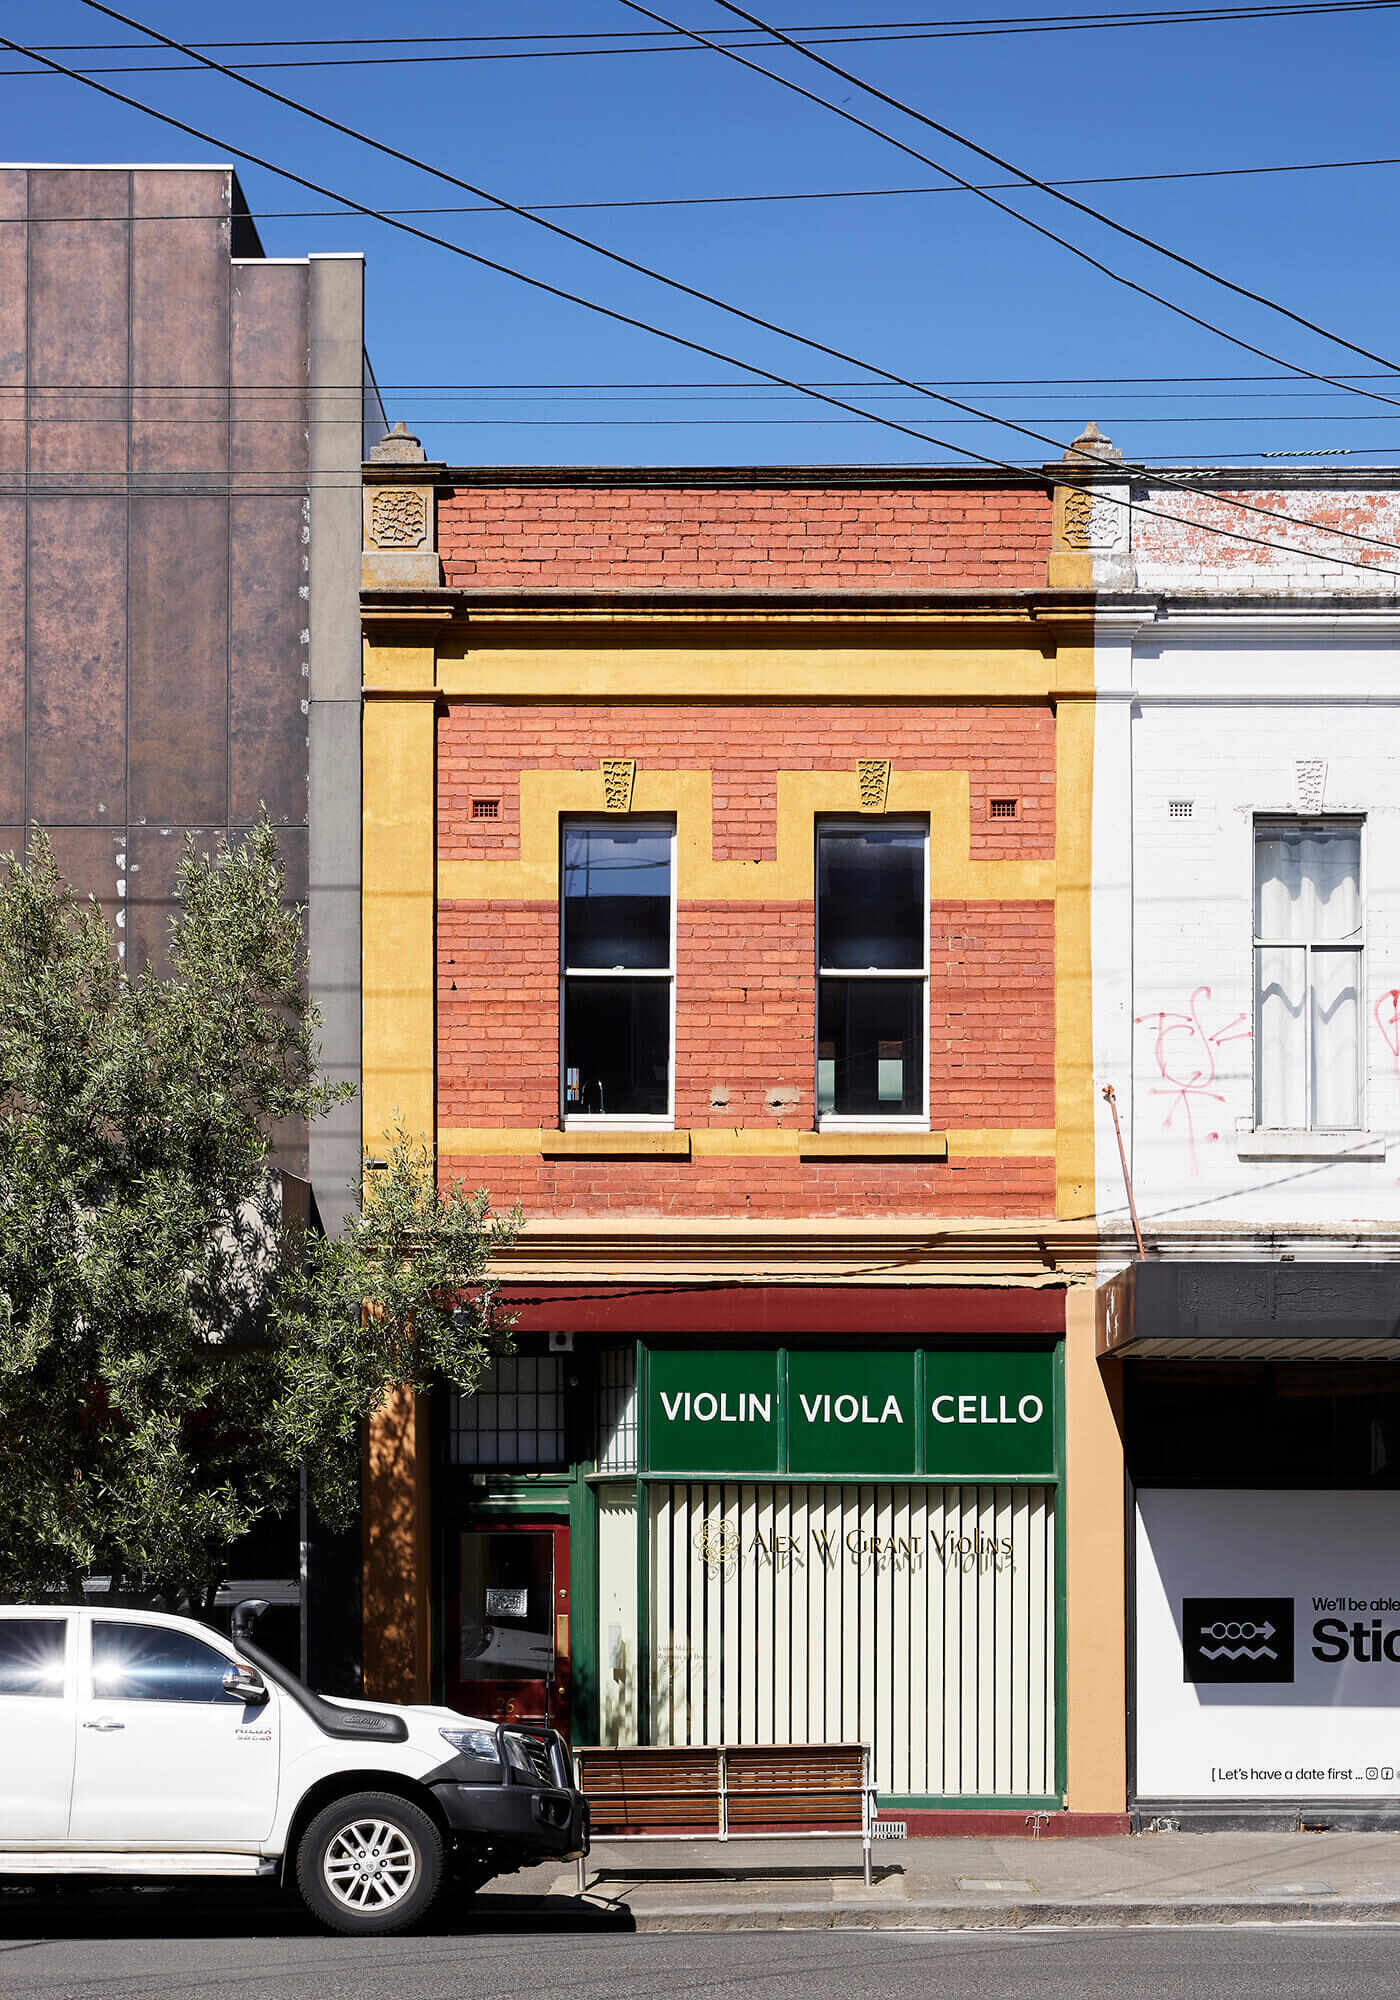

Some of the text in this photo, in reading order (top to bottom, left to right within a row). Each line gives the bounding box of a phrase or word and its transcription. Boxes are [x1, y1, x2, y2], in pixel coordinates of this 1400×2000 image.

[659, 1391, 771, 1422] VIOLIN
[799, 1394, 904, 1424] VIOLA
[931, 1395, 1043, 1424] CELLO
[811, 1529, 836, 1554] W
[1311, 1597, 1400, 1612] We'll be able
[1218, 1768, 1249, 1781] Let's
[1250, 1768, 1283, 1781] have
[1284, 1770, 1293, 1781] a
[1295, 1767, 1325, 1781] date
[1327, 1767, 1353, 1781] first
